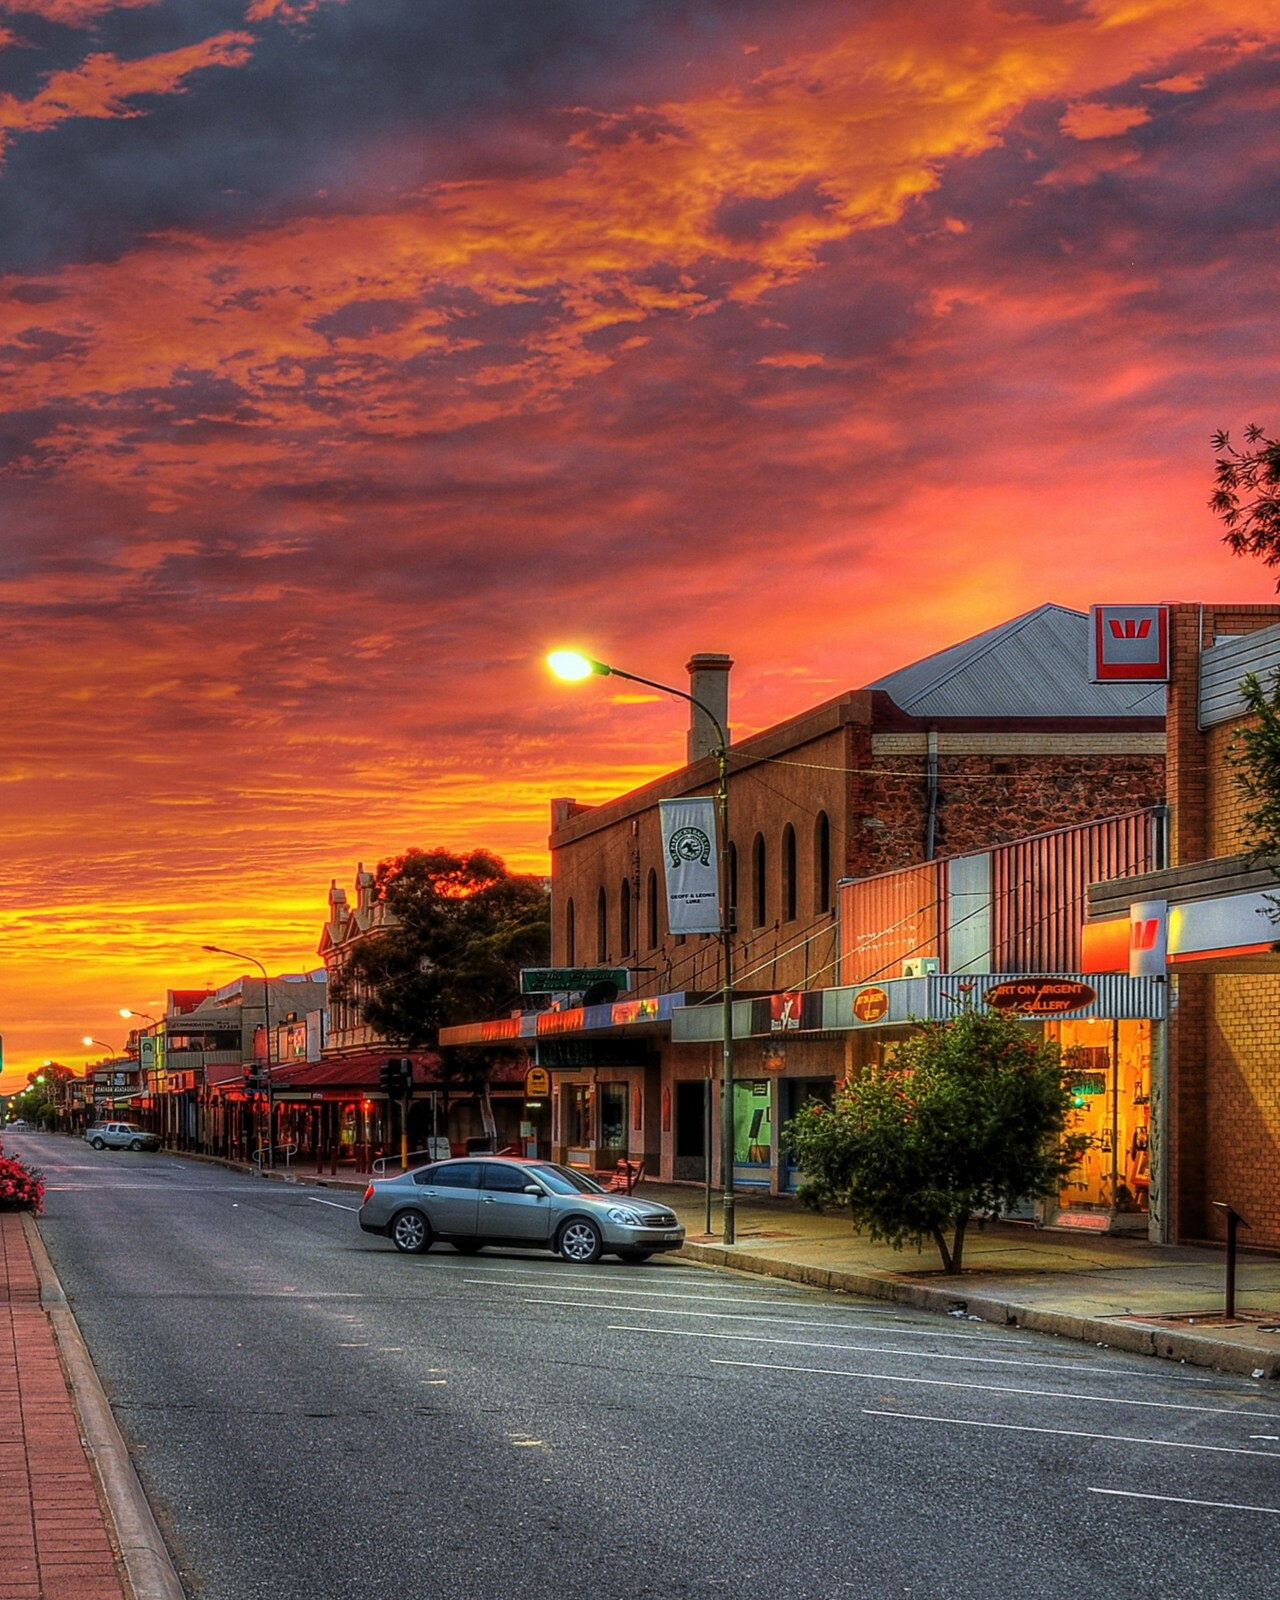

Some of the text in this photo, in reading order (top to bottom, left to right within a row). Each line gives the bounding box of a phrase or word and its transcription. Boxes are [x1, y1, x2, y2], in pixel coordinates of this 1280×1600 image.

[1017, 985, 1036, 995] ON
[1037, 984, 1083, 995] ARGENT
[1023, 1001, 1070, 1011] GALLERY
